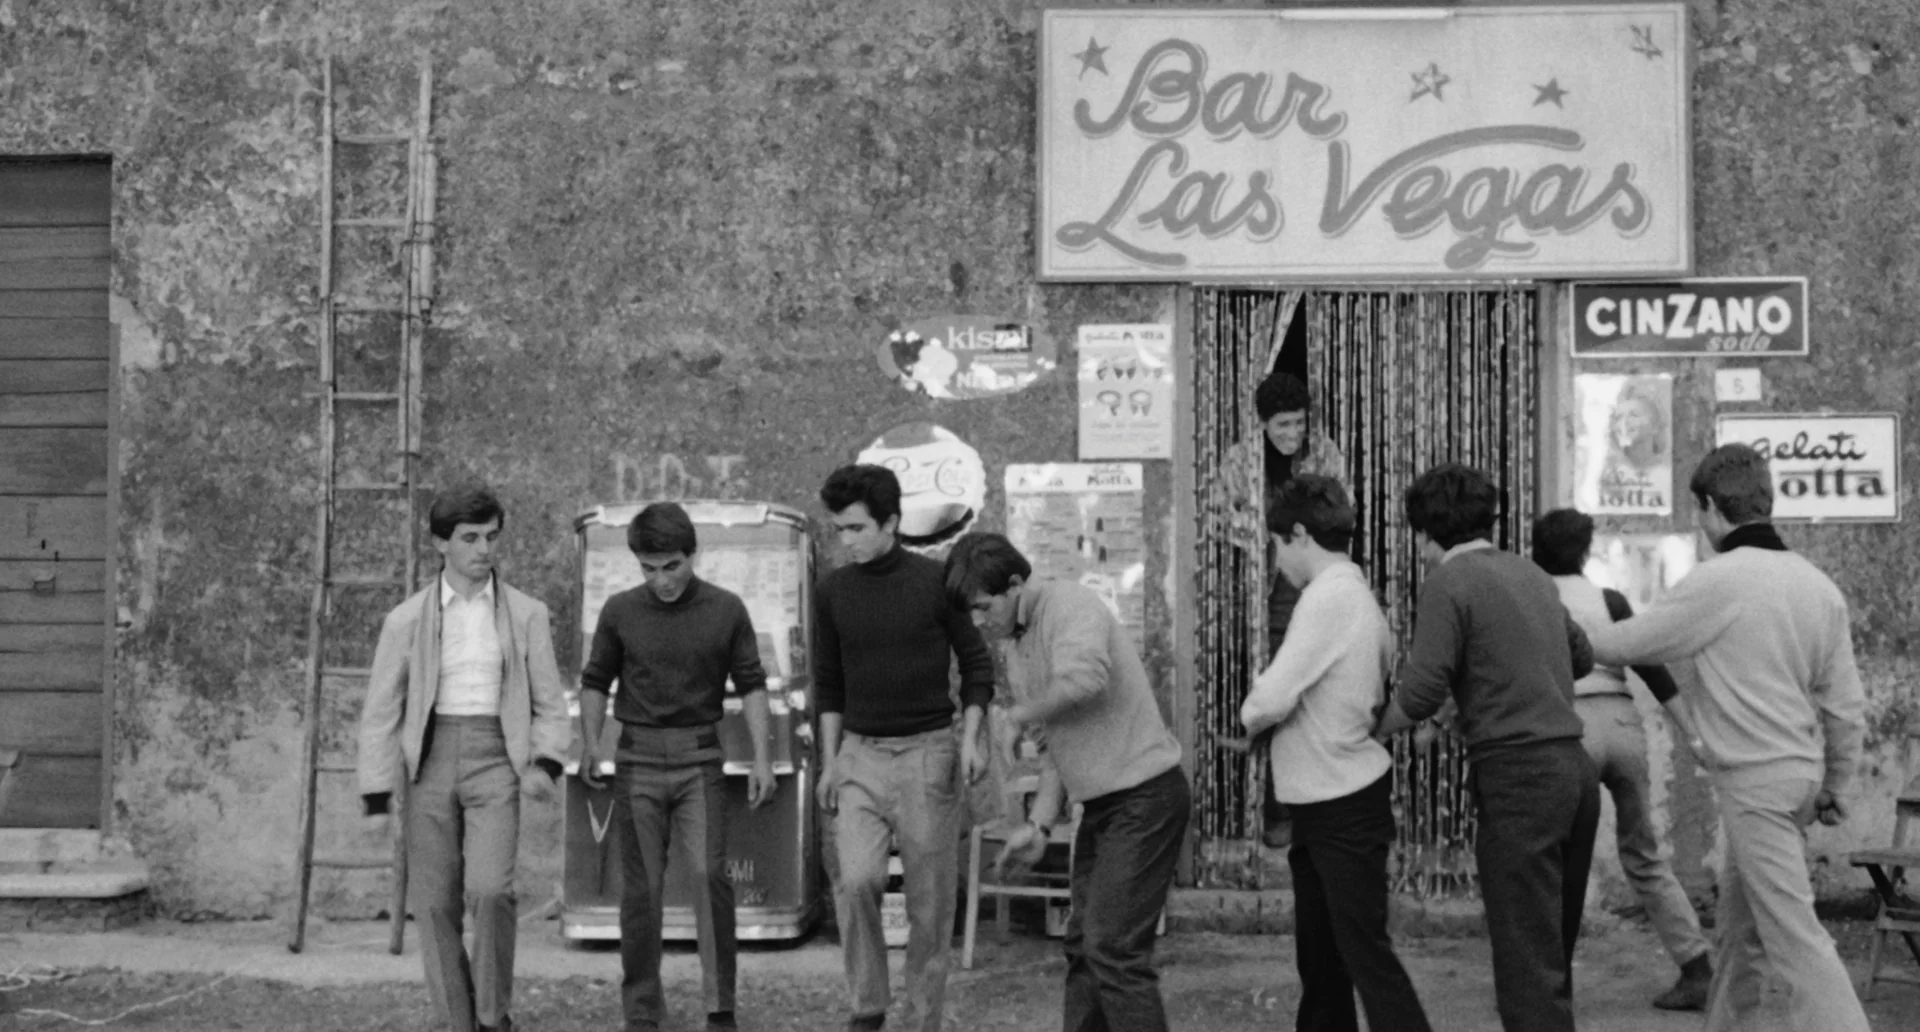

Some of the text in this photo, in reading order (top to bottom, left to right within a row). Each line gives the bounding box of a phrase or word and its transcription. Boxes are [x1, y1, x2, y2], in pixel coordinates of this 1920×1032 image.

[1073, 38, 1347, 141] Bar
[1056, 124, 1652, 271] Las Vegas
[1585, 293, 1793, 338] CINZANO
[1705, 327, 1772, 352] soda
[1779, 468, 1887, 498] otta
